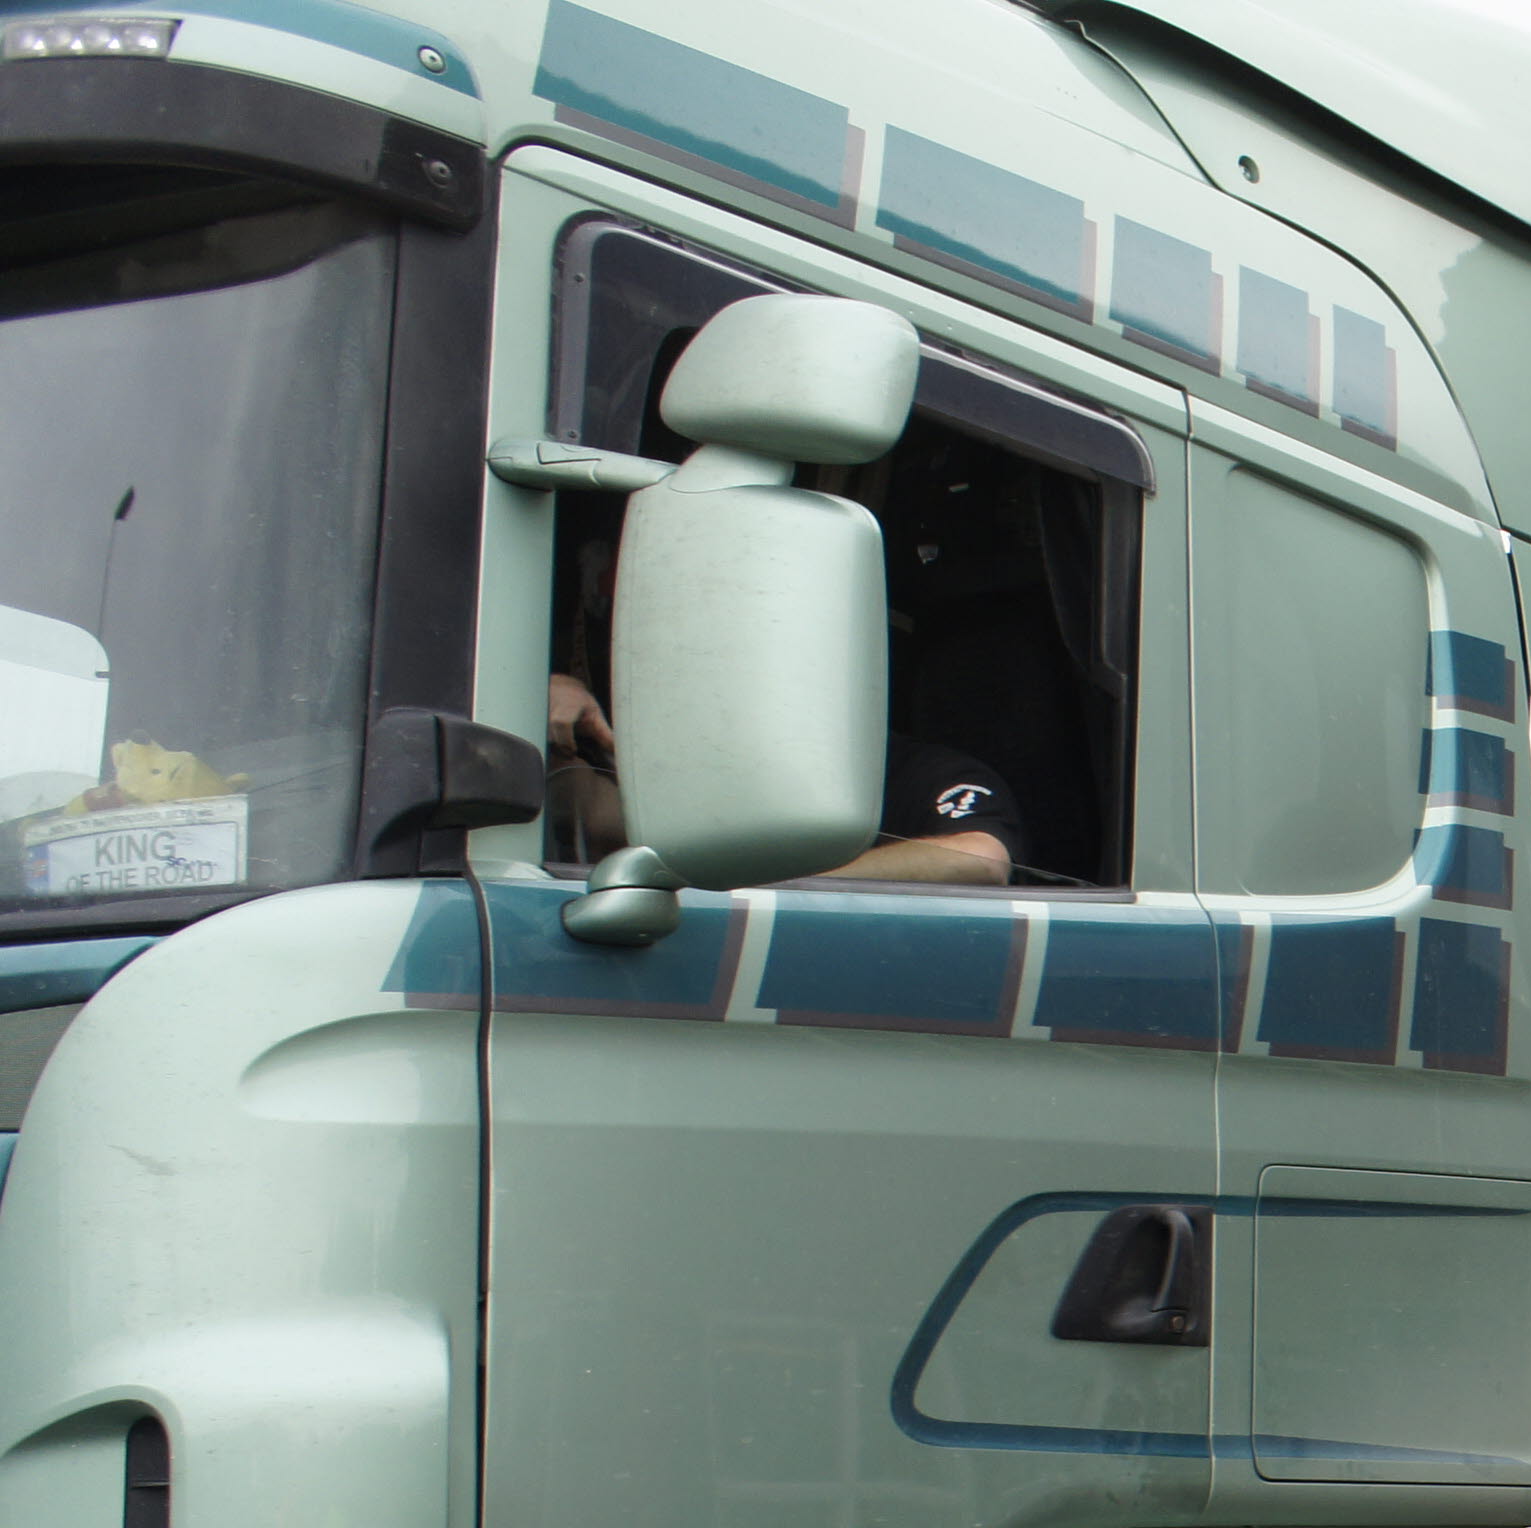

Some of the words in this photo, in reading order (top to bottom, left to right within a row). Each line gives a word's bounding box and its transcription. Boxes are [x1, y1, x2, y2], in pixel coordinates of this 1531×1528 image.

[94, 830, 177, 868] KING
[65, 873, 91, 894] OF
[96, 868, 138, 890] THE
[144, 862, 214, 887] ROAD
